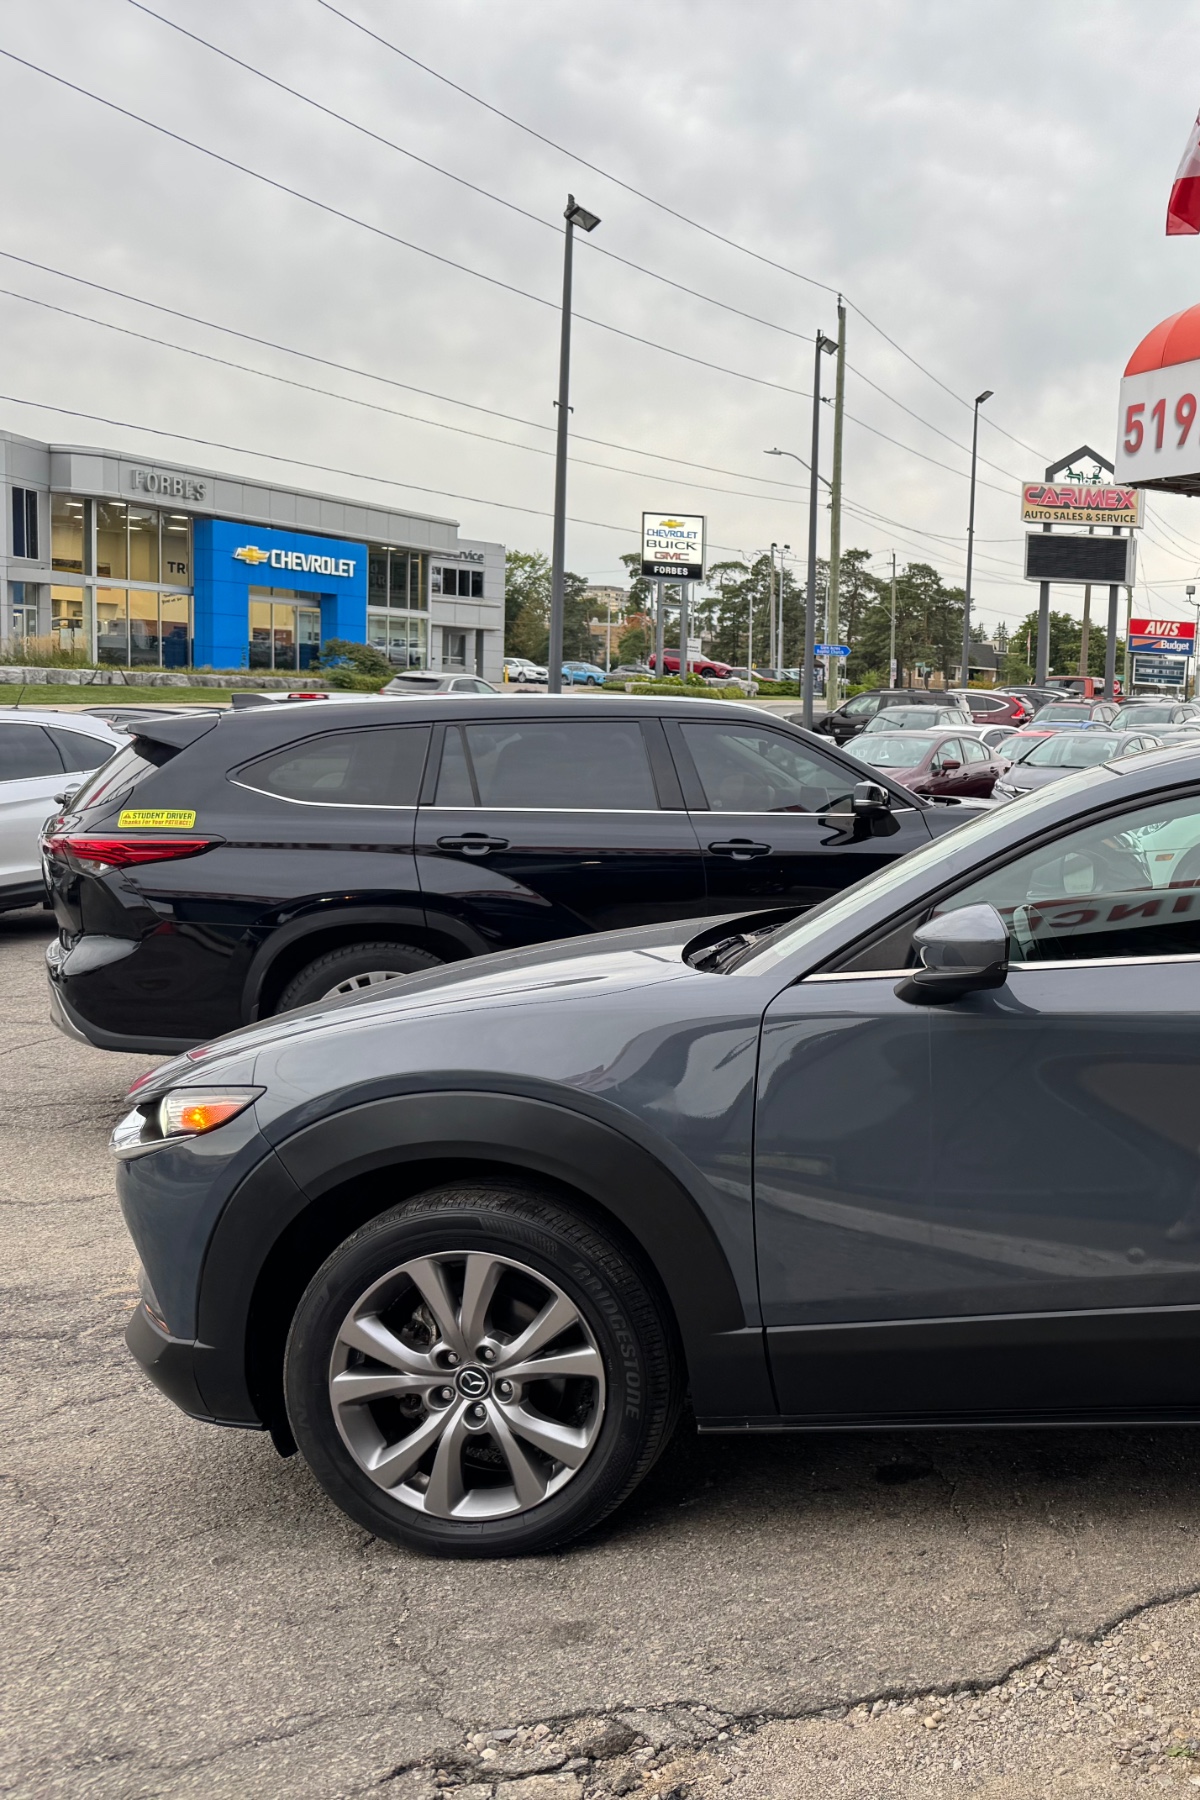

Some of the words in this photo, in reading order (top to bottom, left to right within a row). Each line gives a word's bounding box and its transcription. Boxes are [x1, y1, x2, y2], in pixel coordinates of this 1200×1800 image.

[131, 469, 207, 501] FORBES
[1024, 486, 1137, 509] CARIMEX
[1024, 510, 1051, 519] AUTO
[1054, 511, 1083, 521] SALES
[1085, 512, 1093, 521] &
[1095, 513, 1136, 523] SERVICE
[646, 528, 698, 539] CHEVROLET
[646, 539, 697, 551] BUICK
[654, 551, 689, 561] GMC
[271, 549, 356, 577] CHEVROLET
[653, 566, 689, 576] FORBES
[1144, 621, 1180, 636] AVIS
[1160, 639, 1190, 652] Budget
[570, 1261, 642, 1420] BRIDGESTONE
